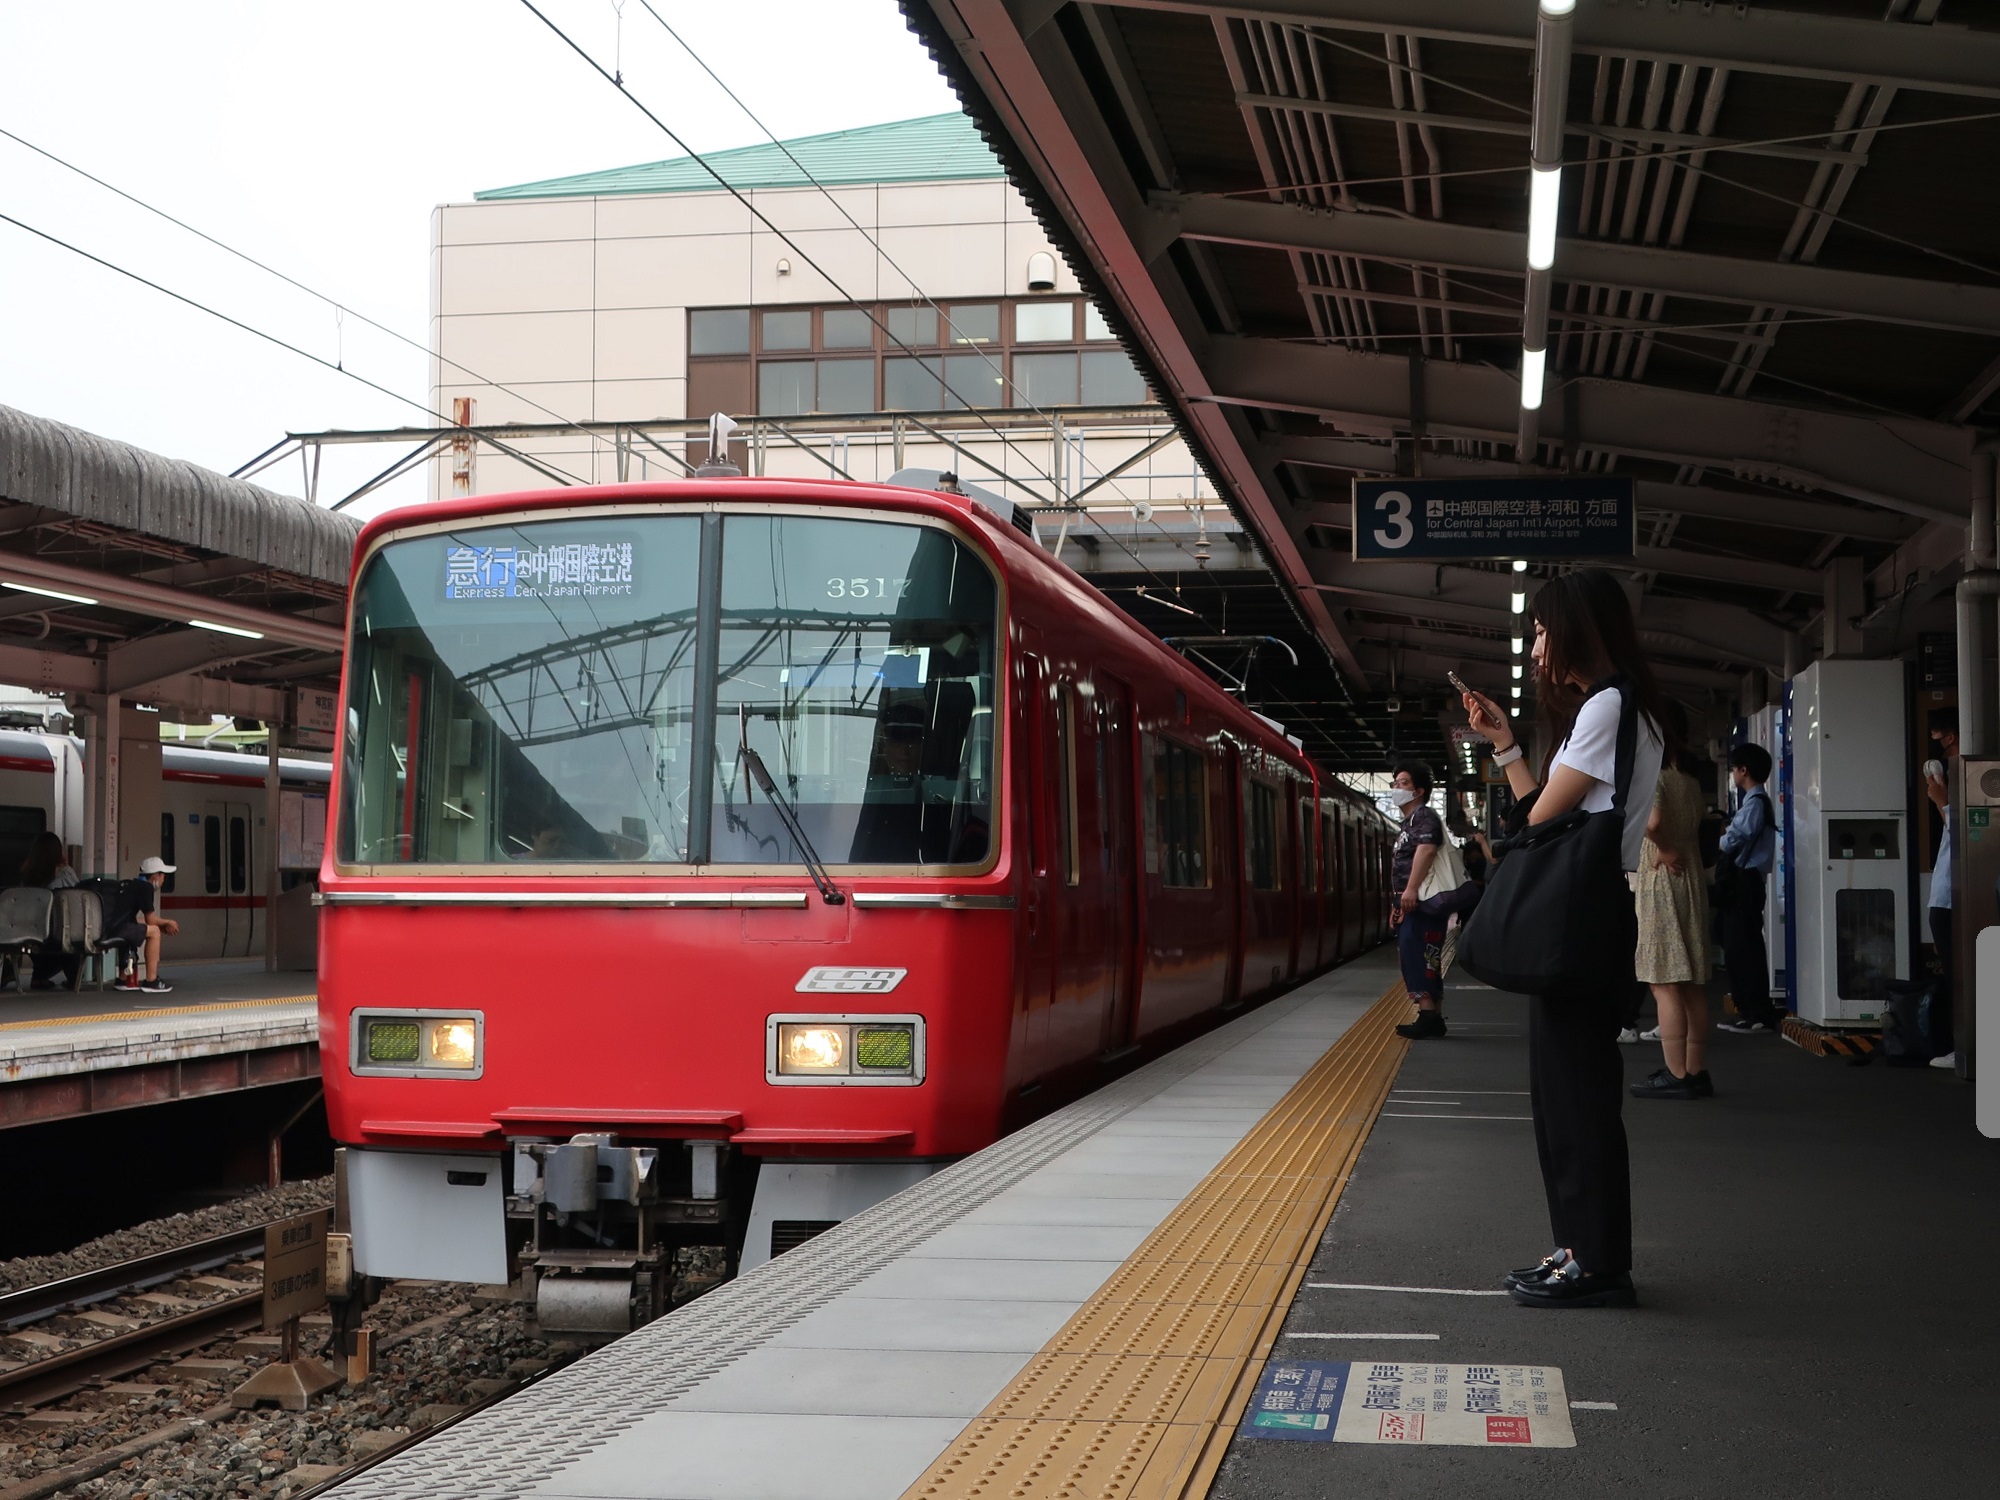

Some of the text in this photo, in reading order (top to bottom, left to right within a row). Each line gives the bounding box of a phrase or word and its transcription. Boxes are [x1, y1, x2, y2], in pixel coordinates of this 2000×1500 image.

[1585, 499, 1617, 515] 方面
[1374, 490, 1414, 549] 3
[1427, 518, 1441, 529] for
[1444, 517, 1483, 529] Central
[1486, 518, 1519, 530] Japan
[447, 547, 515, 586] 急行
[454, 587, 505, 599] Express
[583, 583, 632, 596] Airport
[827, 577, 912, 598] 3517
[1497, 786, 1505, 798] 3
[1361, 1365, 1405, 1410] 8両編成 3号車
[1463, 1367, 1503, 1413] 6両編成 2号車
[1261, 1390, 1298, 1410] 特別車
[1406, 1397, 1426, 1408] Cars
